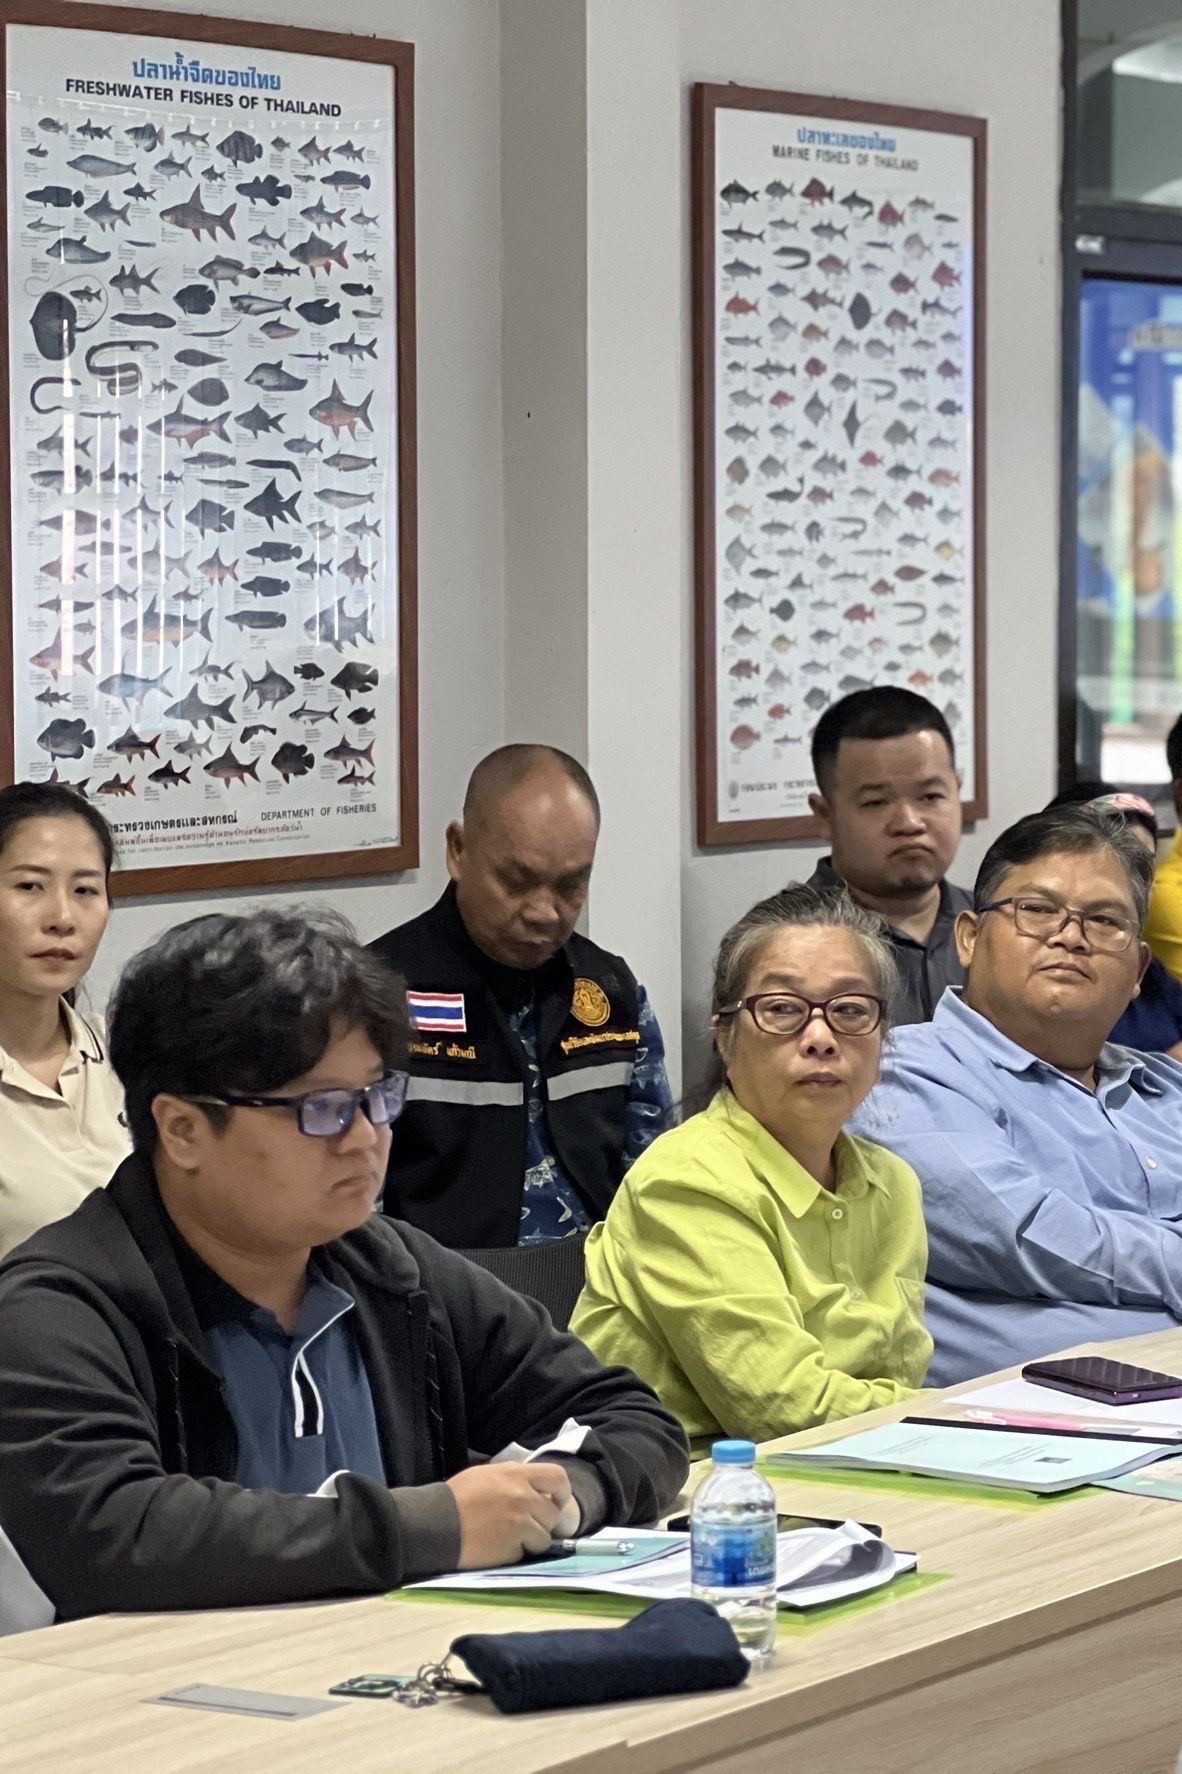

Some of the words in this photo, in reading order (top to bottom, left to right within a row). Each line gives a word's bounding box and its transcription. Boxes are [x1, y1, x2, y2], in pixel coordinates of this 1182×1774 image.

[132, 51, 282, 91] ปลาน้ำจืดของไทย
[65, 78, 173, 102] FRESHWATER
[180, 89, 234, 108] FISHES
[238, 94, 259, 110] OF
[263, 97, 342, 118] THAILAND
[772, 144, 811, 162] MARINE
[815, 148, 850, 165] FISHES
[855, 153, 869, 166] OF
[874, 155, 919, 172] THAILAND
[260, 807, 315, 821] DEPARTMENT
[320, 805, 332, 816] OF
[336, 802, 377, 815] FISHERIES
